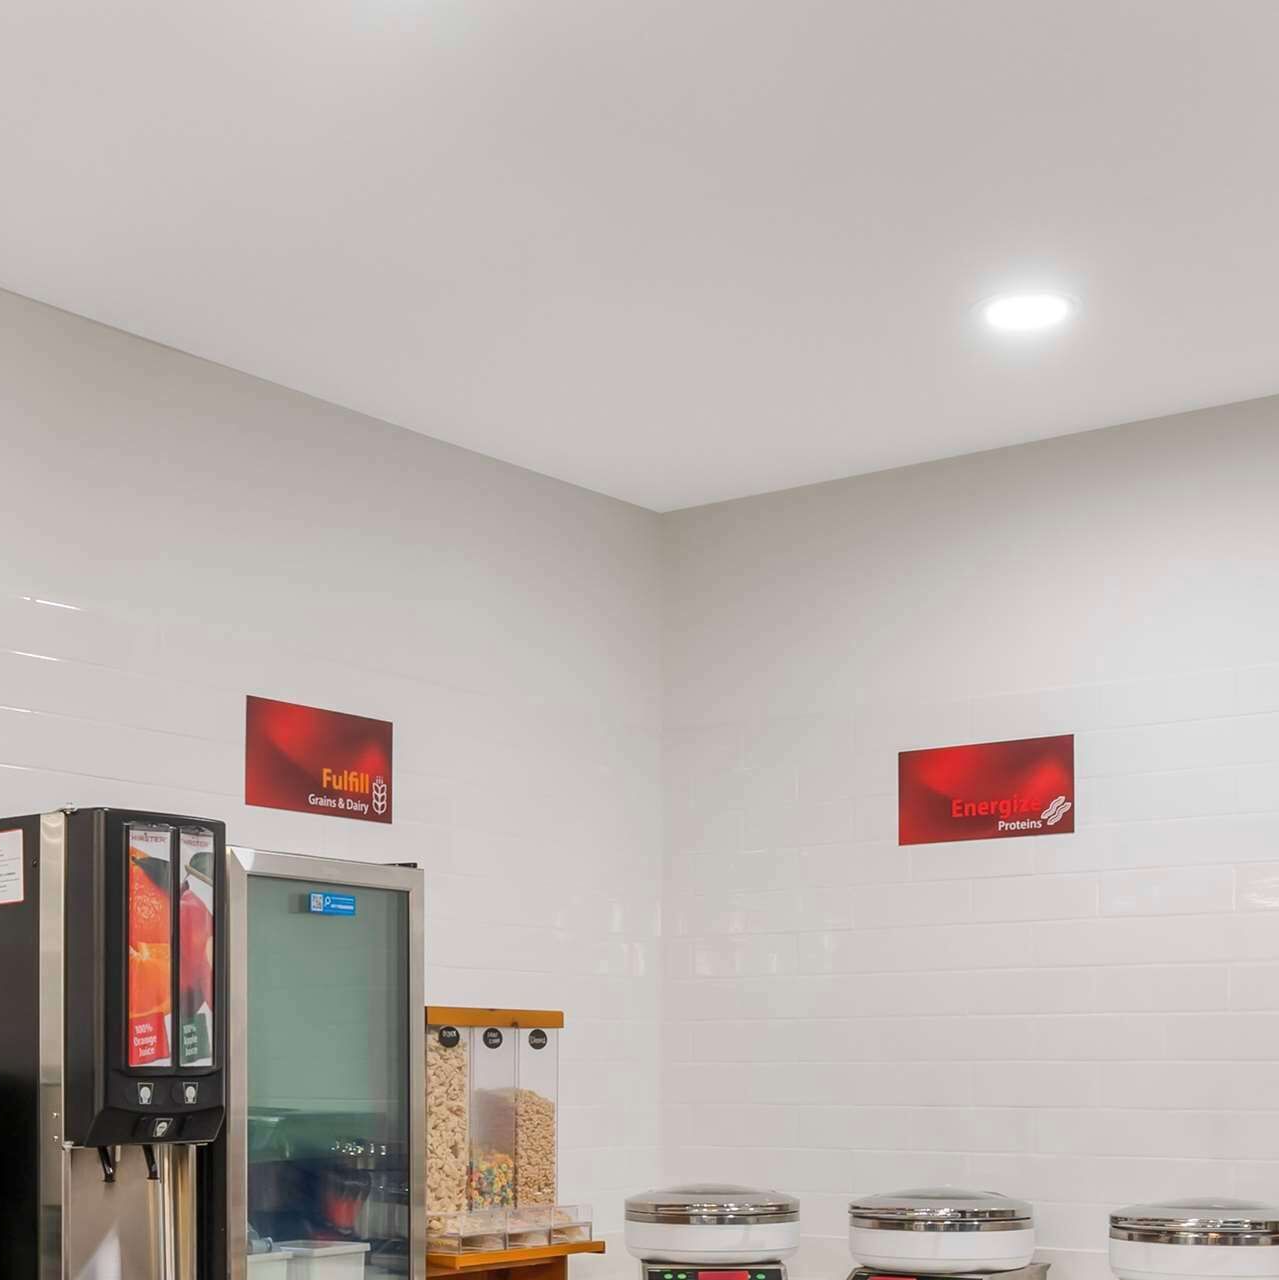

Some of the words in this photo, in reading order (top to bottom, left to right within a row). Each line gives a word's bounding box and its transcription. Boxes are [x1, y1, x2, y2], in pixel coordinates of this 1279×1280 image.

[322, 768, 370, 795] Fulfill
[308, 793, 337, 809] Grains
[338, 799, 346, 809] &
[346, 799, 369, 816] Dairy
[951, 794, 1041, 820] Energize
[998, 819, 1042, 832] Proteins
